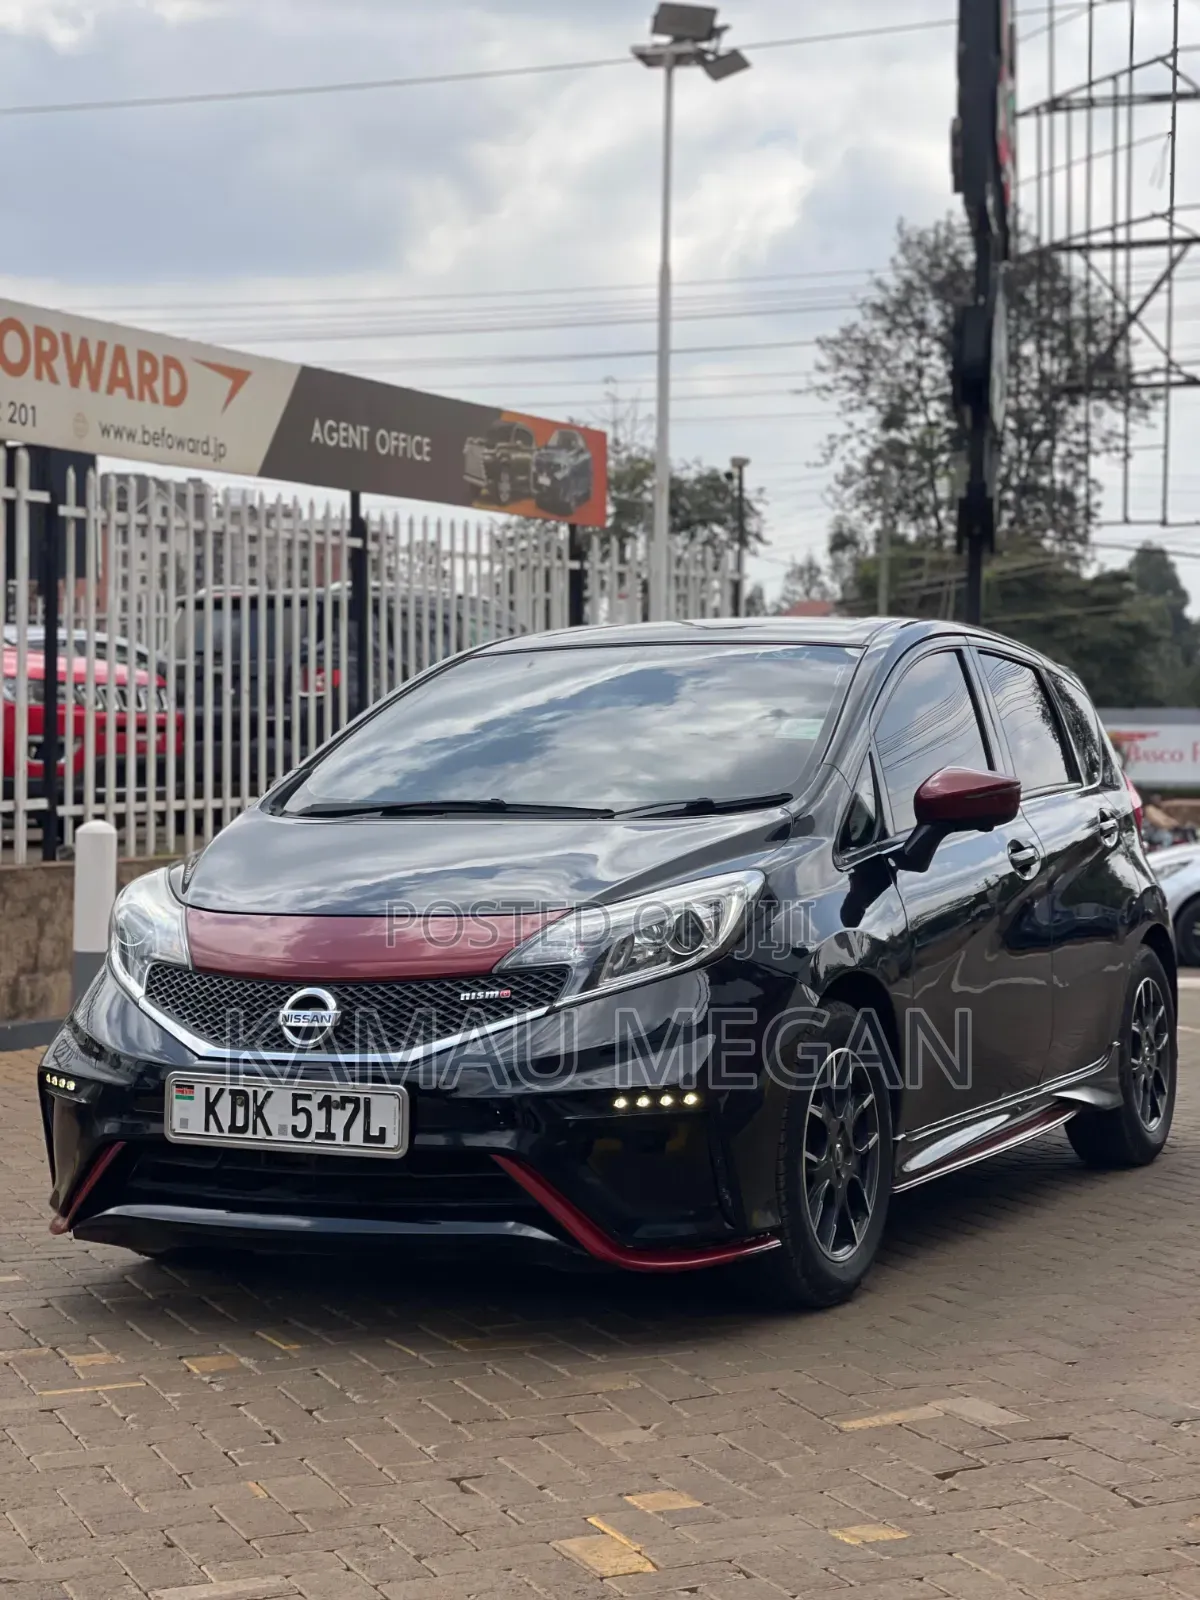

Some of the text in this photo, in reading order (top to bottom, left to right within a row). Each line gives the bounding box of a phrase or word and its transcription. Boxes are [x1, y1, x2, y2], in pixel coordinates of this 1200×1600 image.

[8, 401, 37, 428] 201
[98, 421, 227, 462] www.befoward.jp
[310, 418, 432, 462] AGENT OFFICE
[460, 989, 512, 1001] nismo
[280, 1012, 332, 1025] NISSAN
[203, 1086, 274, 1137] KDK
[290, 1092, 387, 1145] 517L
